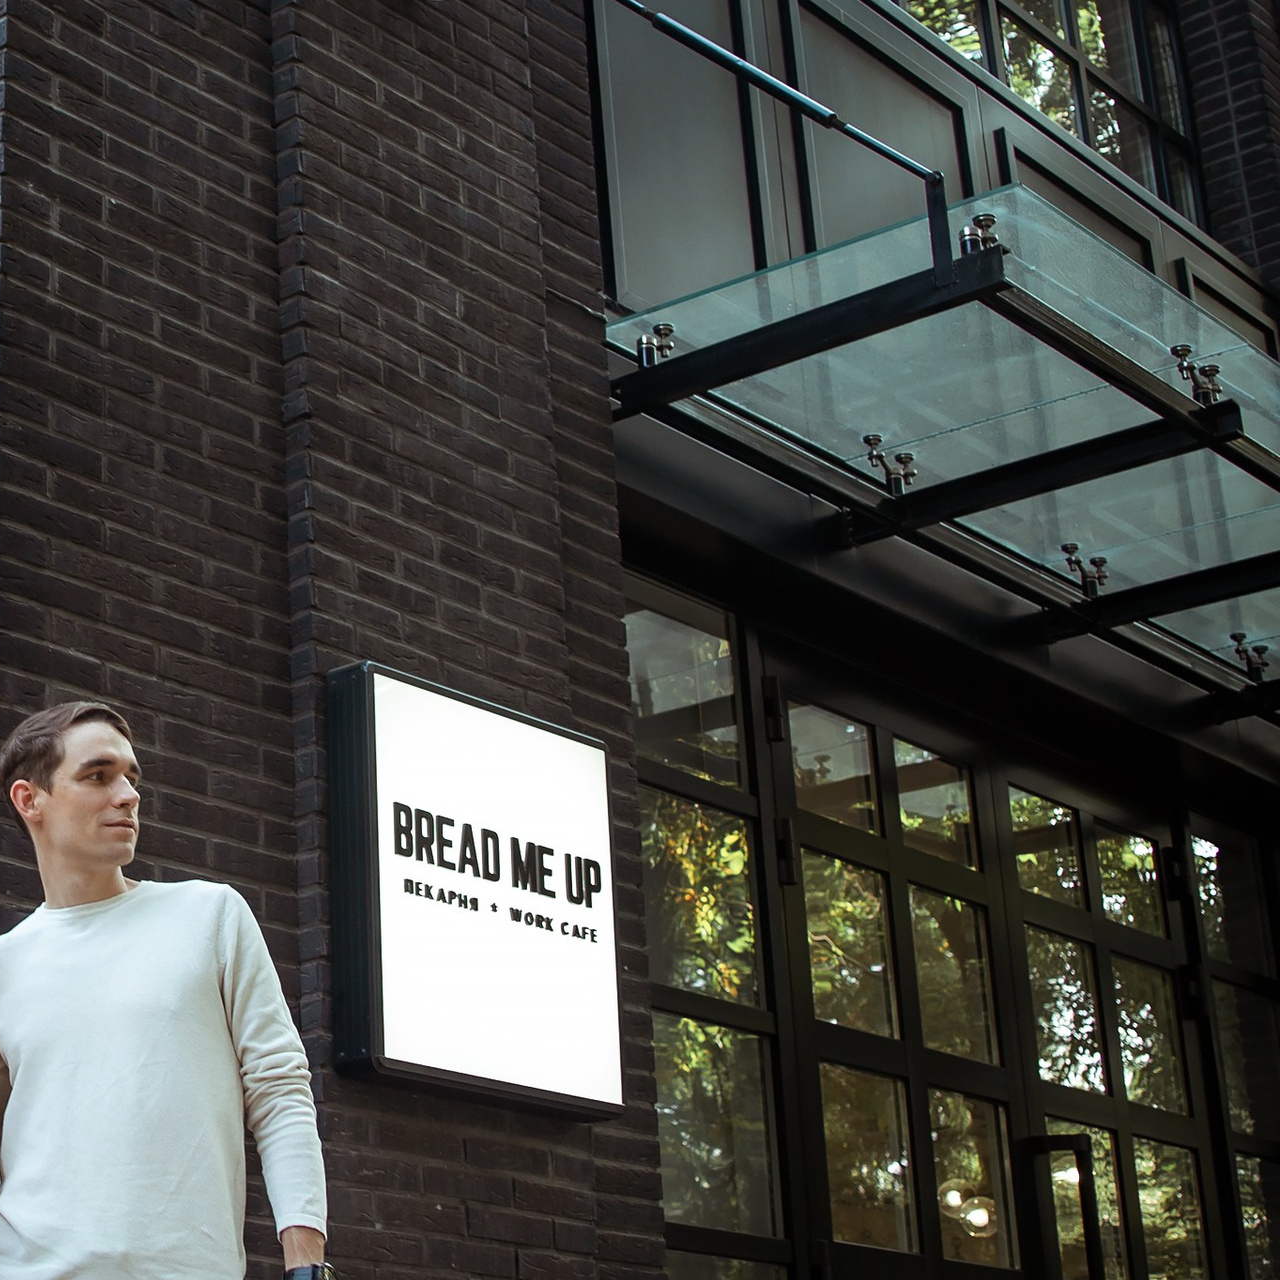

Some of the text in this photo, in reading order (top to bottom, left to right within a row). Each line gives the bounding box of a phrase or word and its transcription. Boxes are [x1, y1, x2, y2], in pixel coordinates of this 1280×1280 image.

[393, 801, 602, 909] BREAD ME UP
[403, 878, 599, 944] ПЕКАРНЯ WORK CAFE
